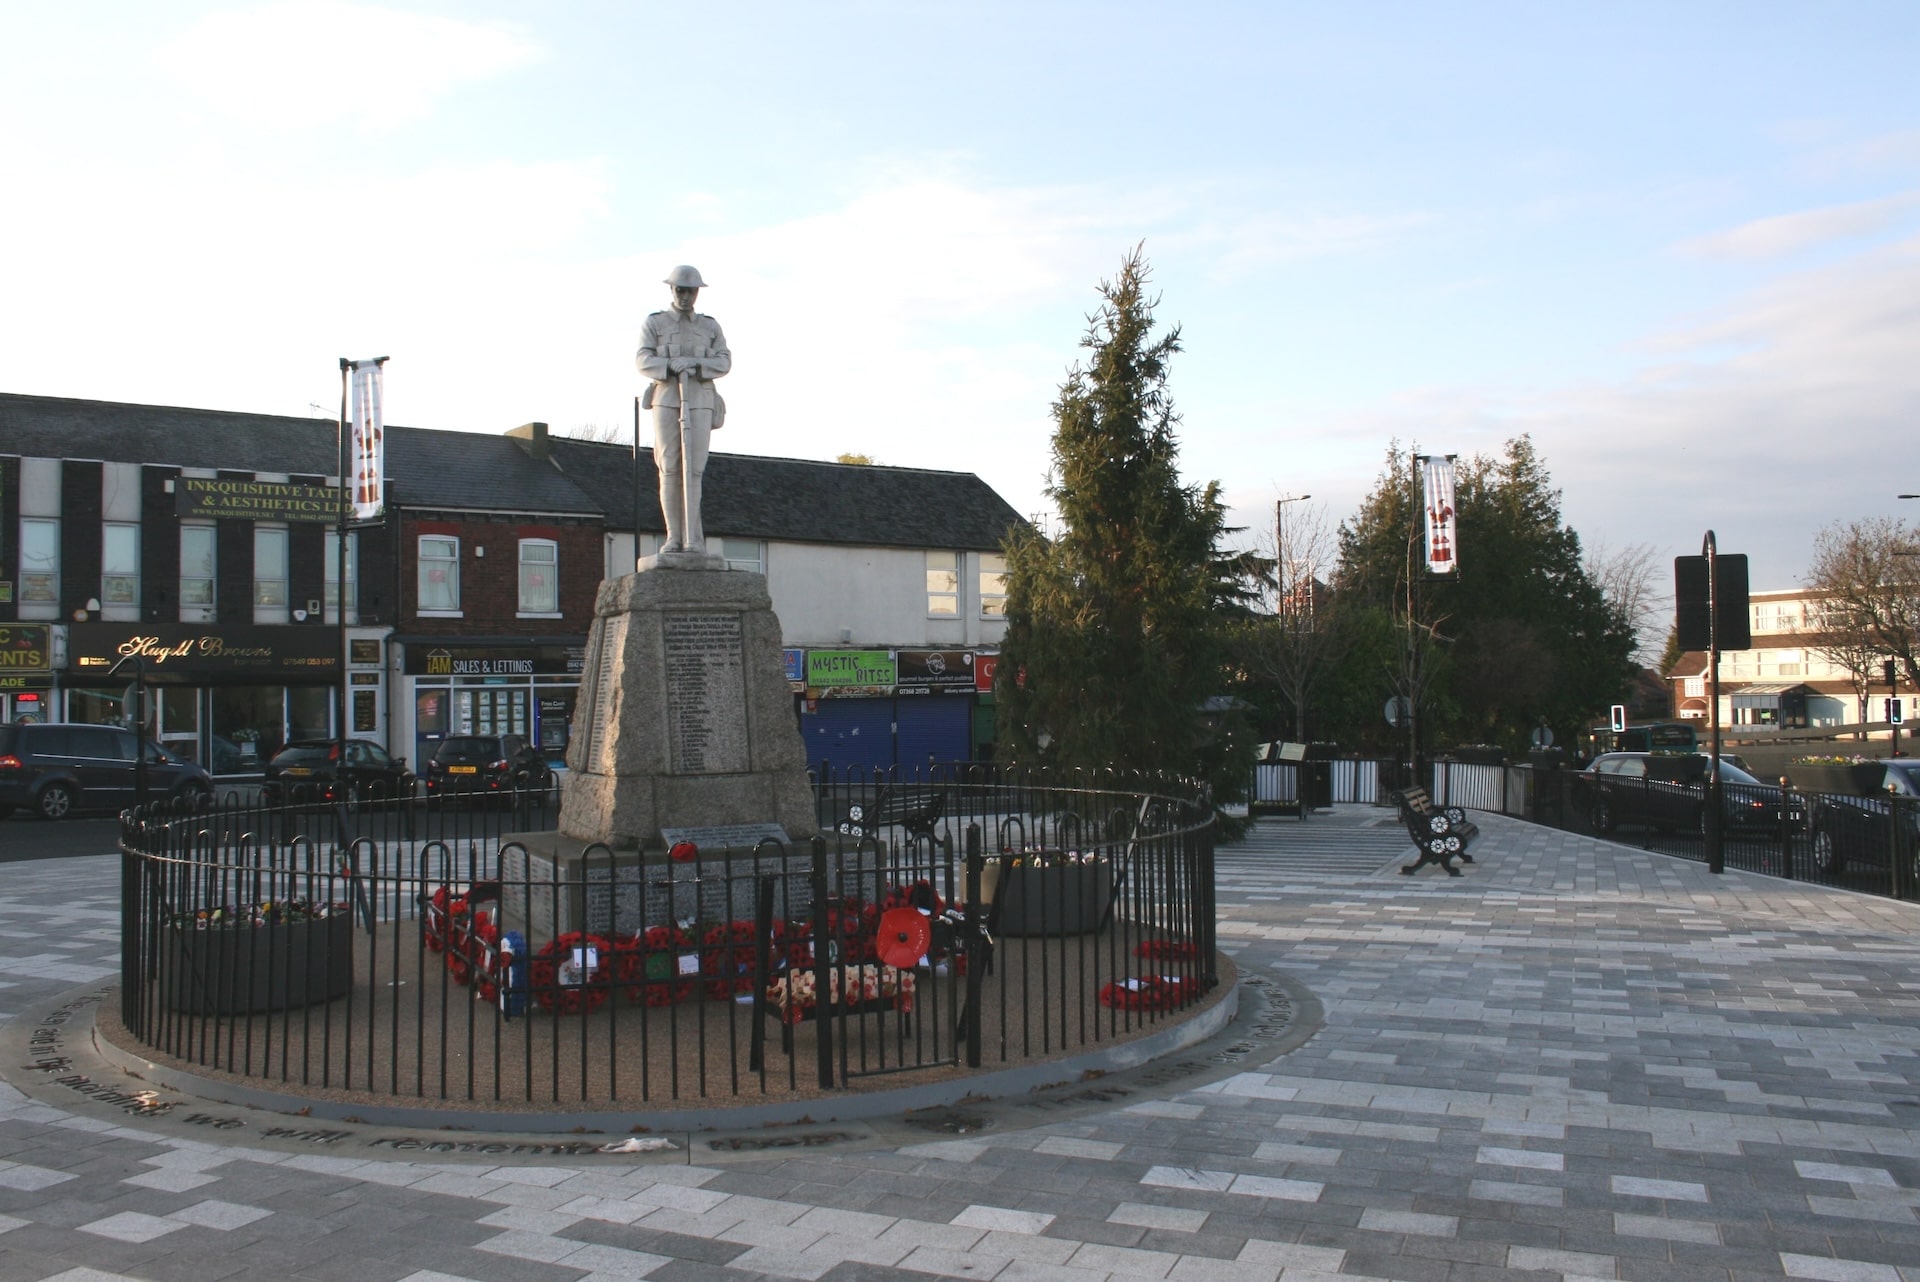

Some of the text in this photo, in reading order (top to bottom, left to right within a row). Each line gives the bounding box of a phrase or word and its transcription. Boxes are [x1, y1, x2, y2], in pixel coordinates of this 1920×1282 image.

[186, 480, 302, 497] INKQUISITIVE
[202, 495, 215, 506] &
[220, 496, 320, 511] AESTHETICS
[199, 636, 272, 657] Browns
[0, 650, 41, 666] NTS
[812, 653, 859, 672] MYSTIC
[453, 660, 480, 674] SALES
[482, 660, 491, 673] &
[493, 659, 533, 674] LETTINGS
[856, 666, 890, 682] BITES
